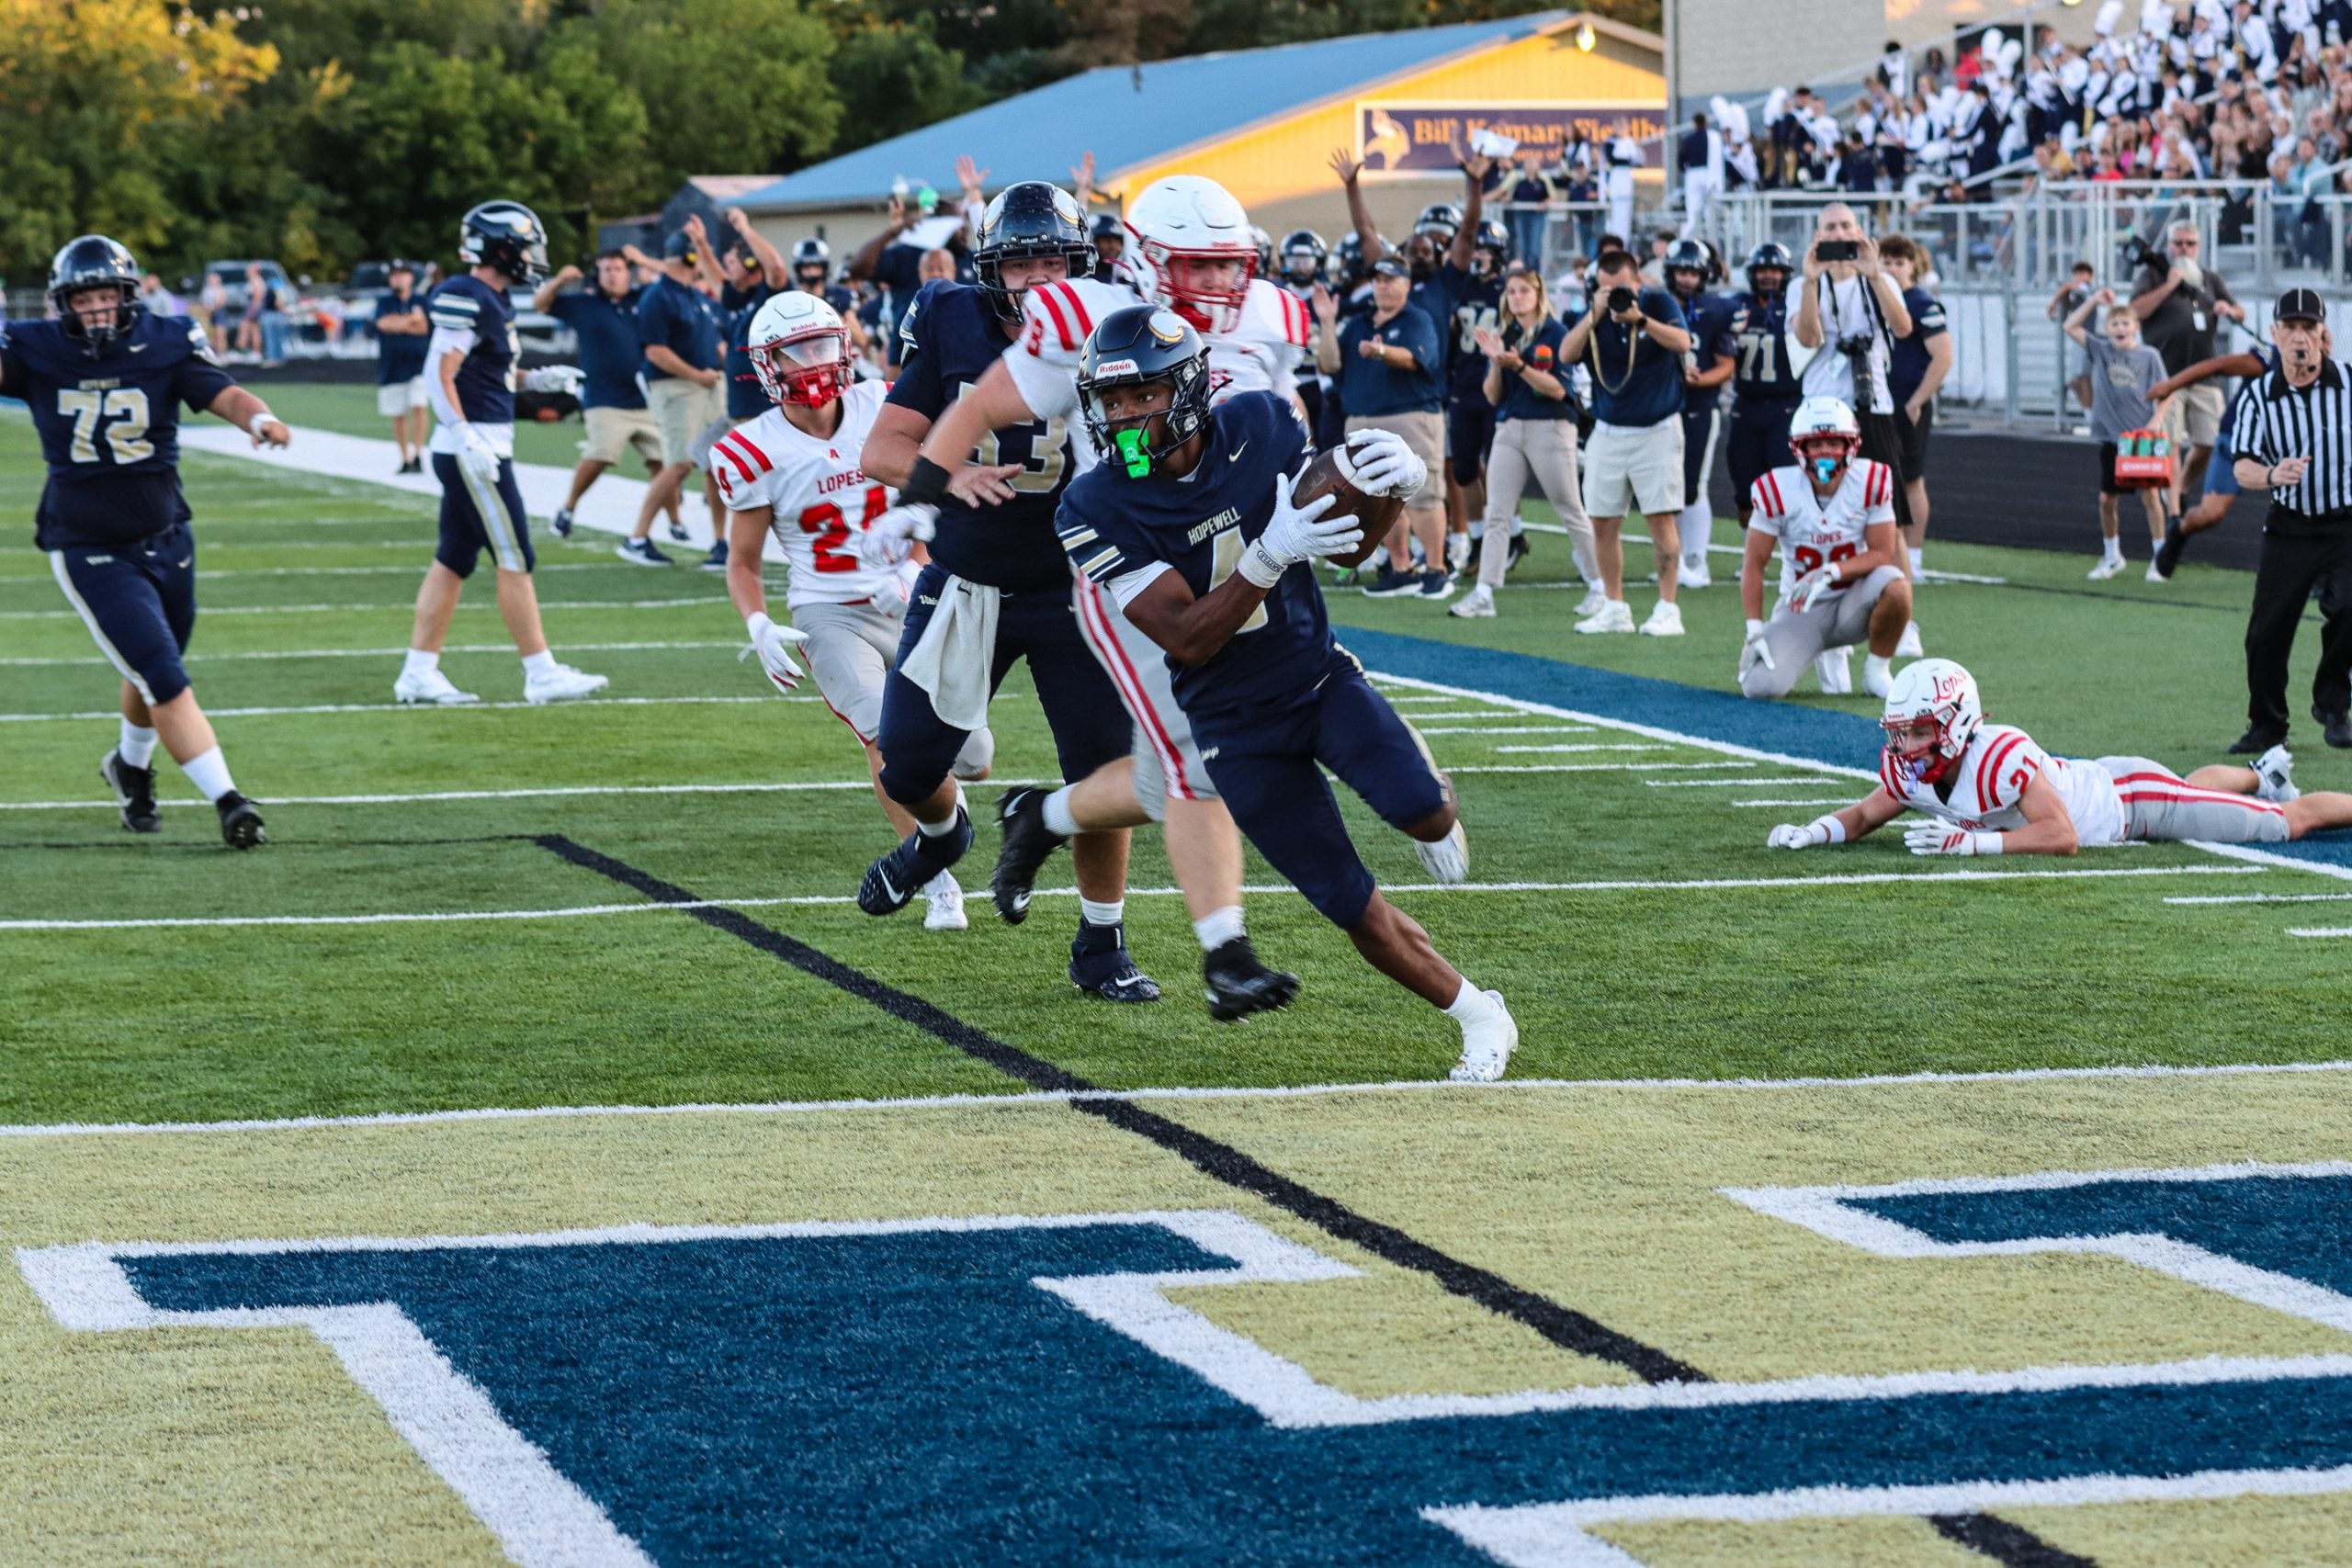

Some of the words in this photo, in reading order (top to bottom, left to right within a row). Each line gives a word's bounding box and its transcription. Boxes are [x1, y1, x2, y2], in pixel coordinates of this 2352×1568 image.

[1099, 362, 1132, 374] Riddell
[1736, 334, 1777, 382] 71
[56, 388, 155, 465] 72
[817, 468, 866, 494] LOPES
[1186, 506, 1242, 546] HOPEWELL
[1810, 531, 1843, 545] LOPES
[2009, 754, 2040, 795] 21
